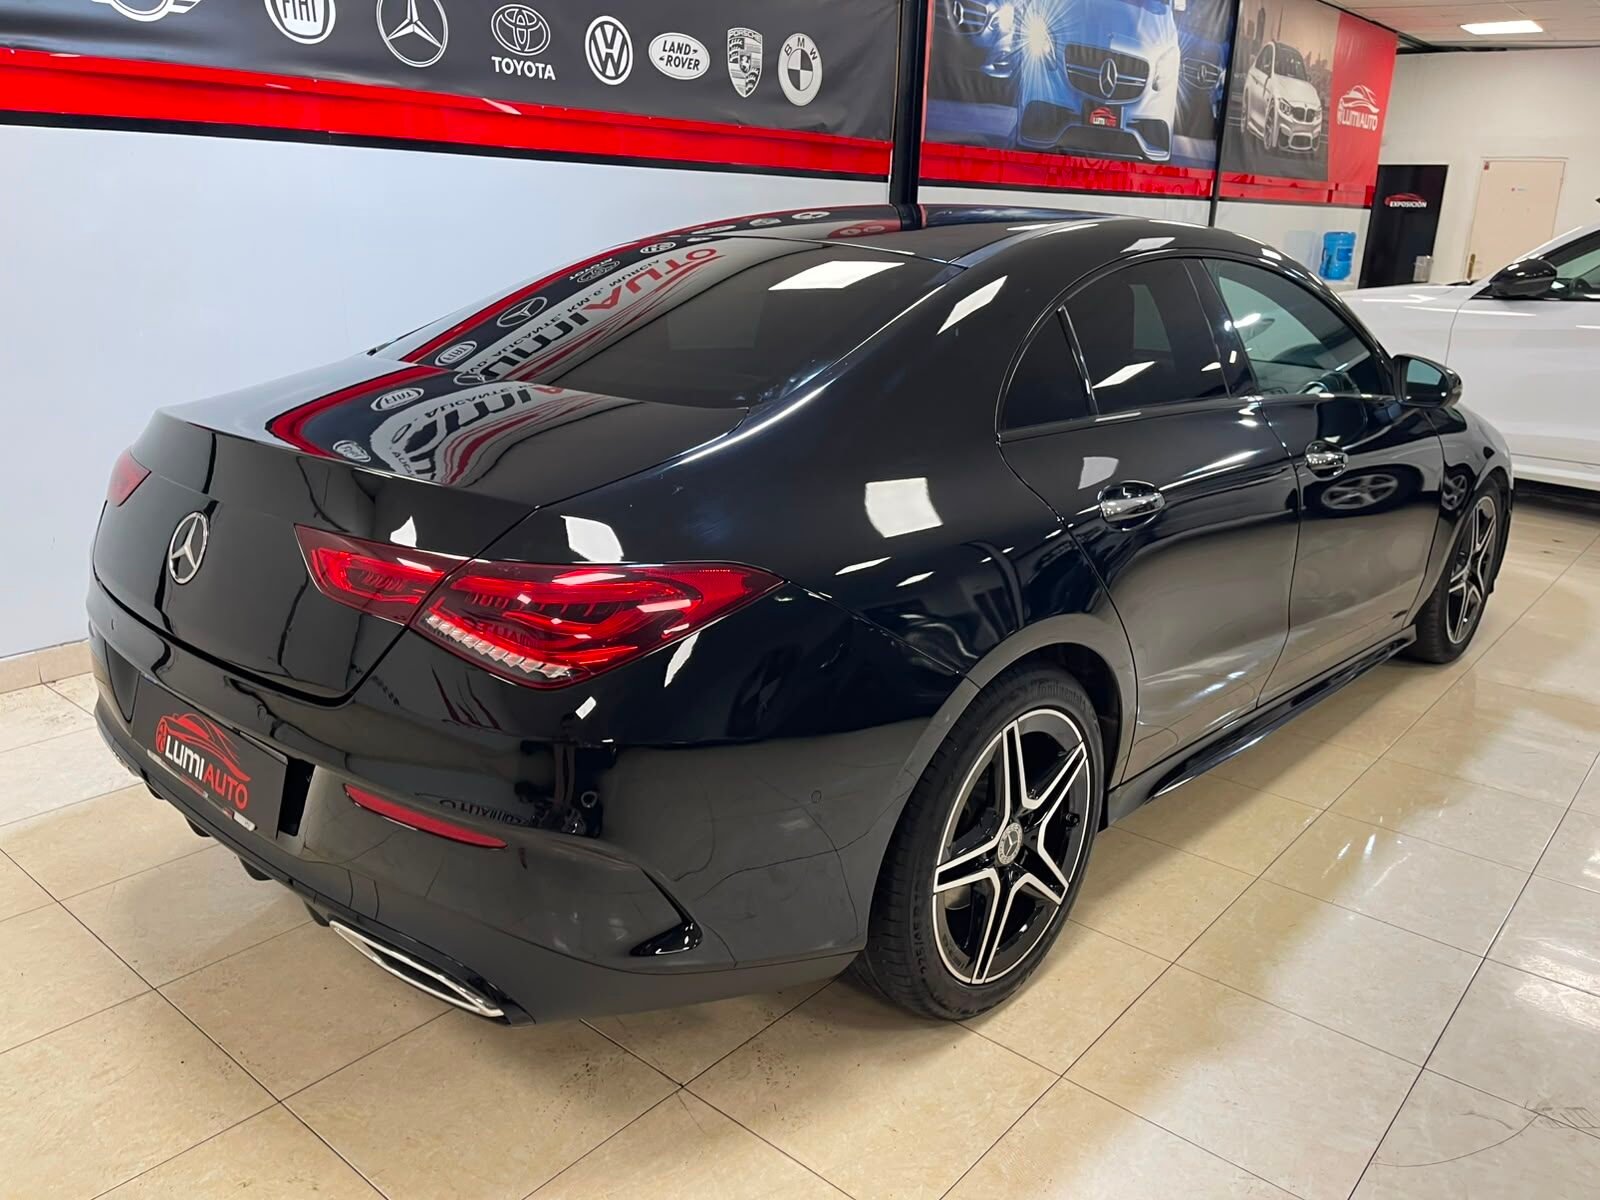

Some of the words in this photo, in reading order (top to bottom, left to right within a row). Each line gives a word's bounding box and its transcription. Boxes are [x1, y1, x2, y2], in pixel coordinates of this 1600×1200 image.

[729, 28, 762, 43] PORSCHE
[784, 36, 818, 61] BMW
[491, 56, 556, 81] TOYOTA
[666, 54, 700, 72] ROVER
